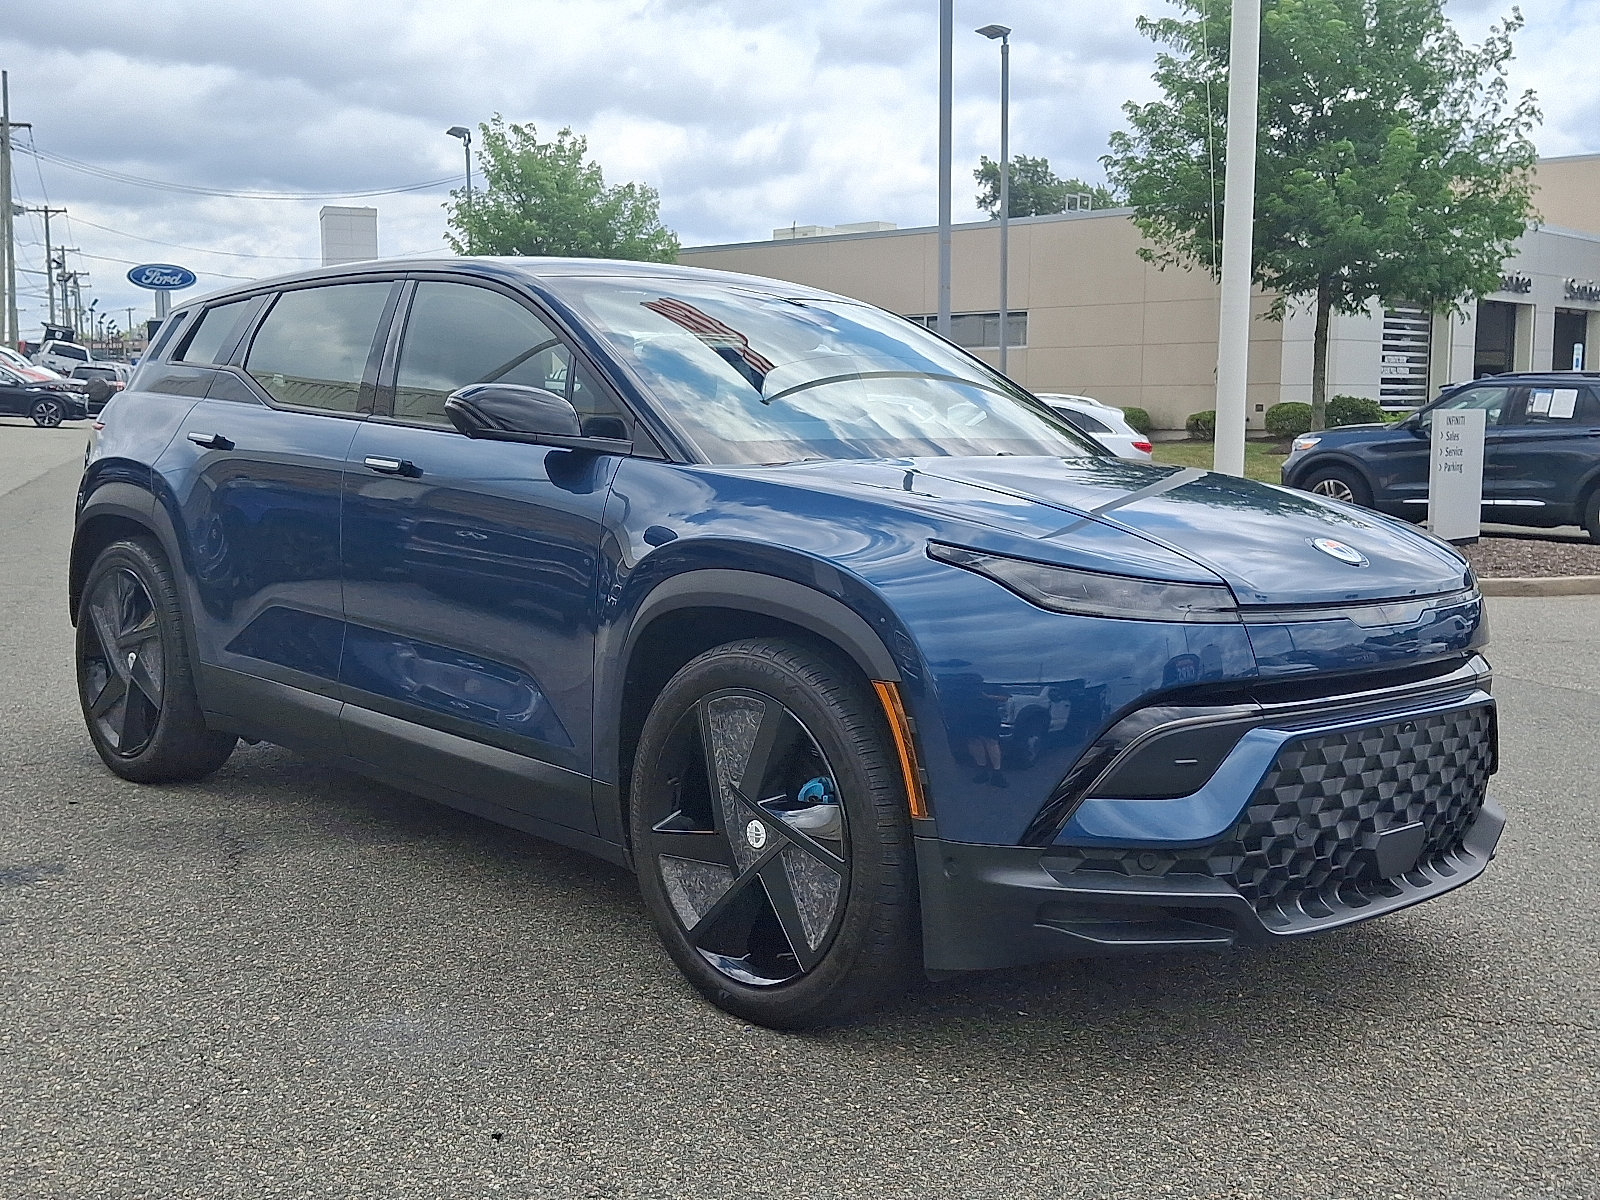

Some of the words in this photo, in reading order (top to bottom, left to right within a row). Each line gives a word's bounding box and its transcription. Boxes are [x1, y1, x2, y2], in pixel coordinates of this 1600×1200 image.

[141, 267, 183, 285] Ford
[1445, 431, 1460, 441] Sales
[1444, 446, 1463, 457] Service
[1443, 462, 1463, 473] Parking
